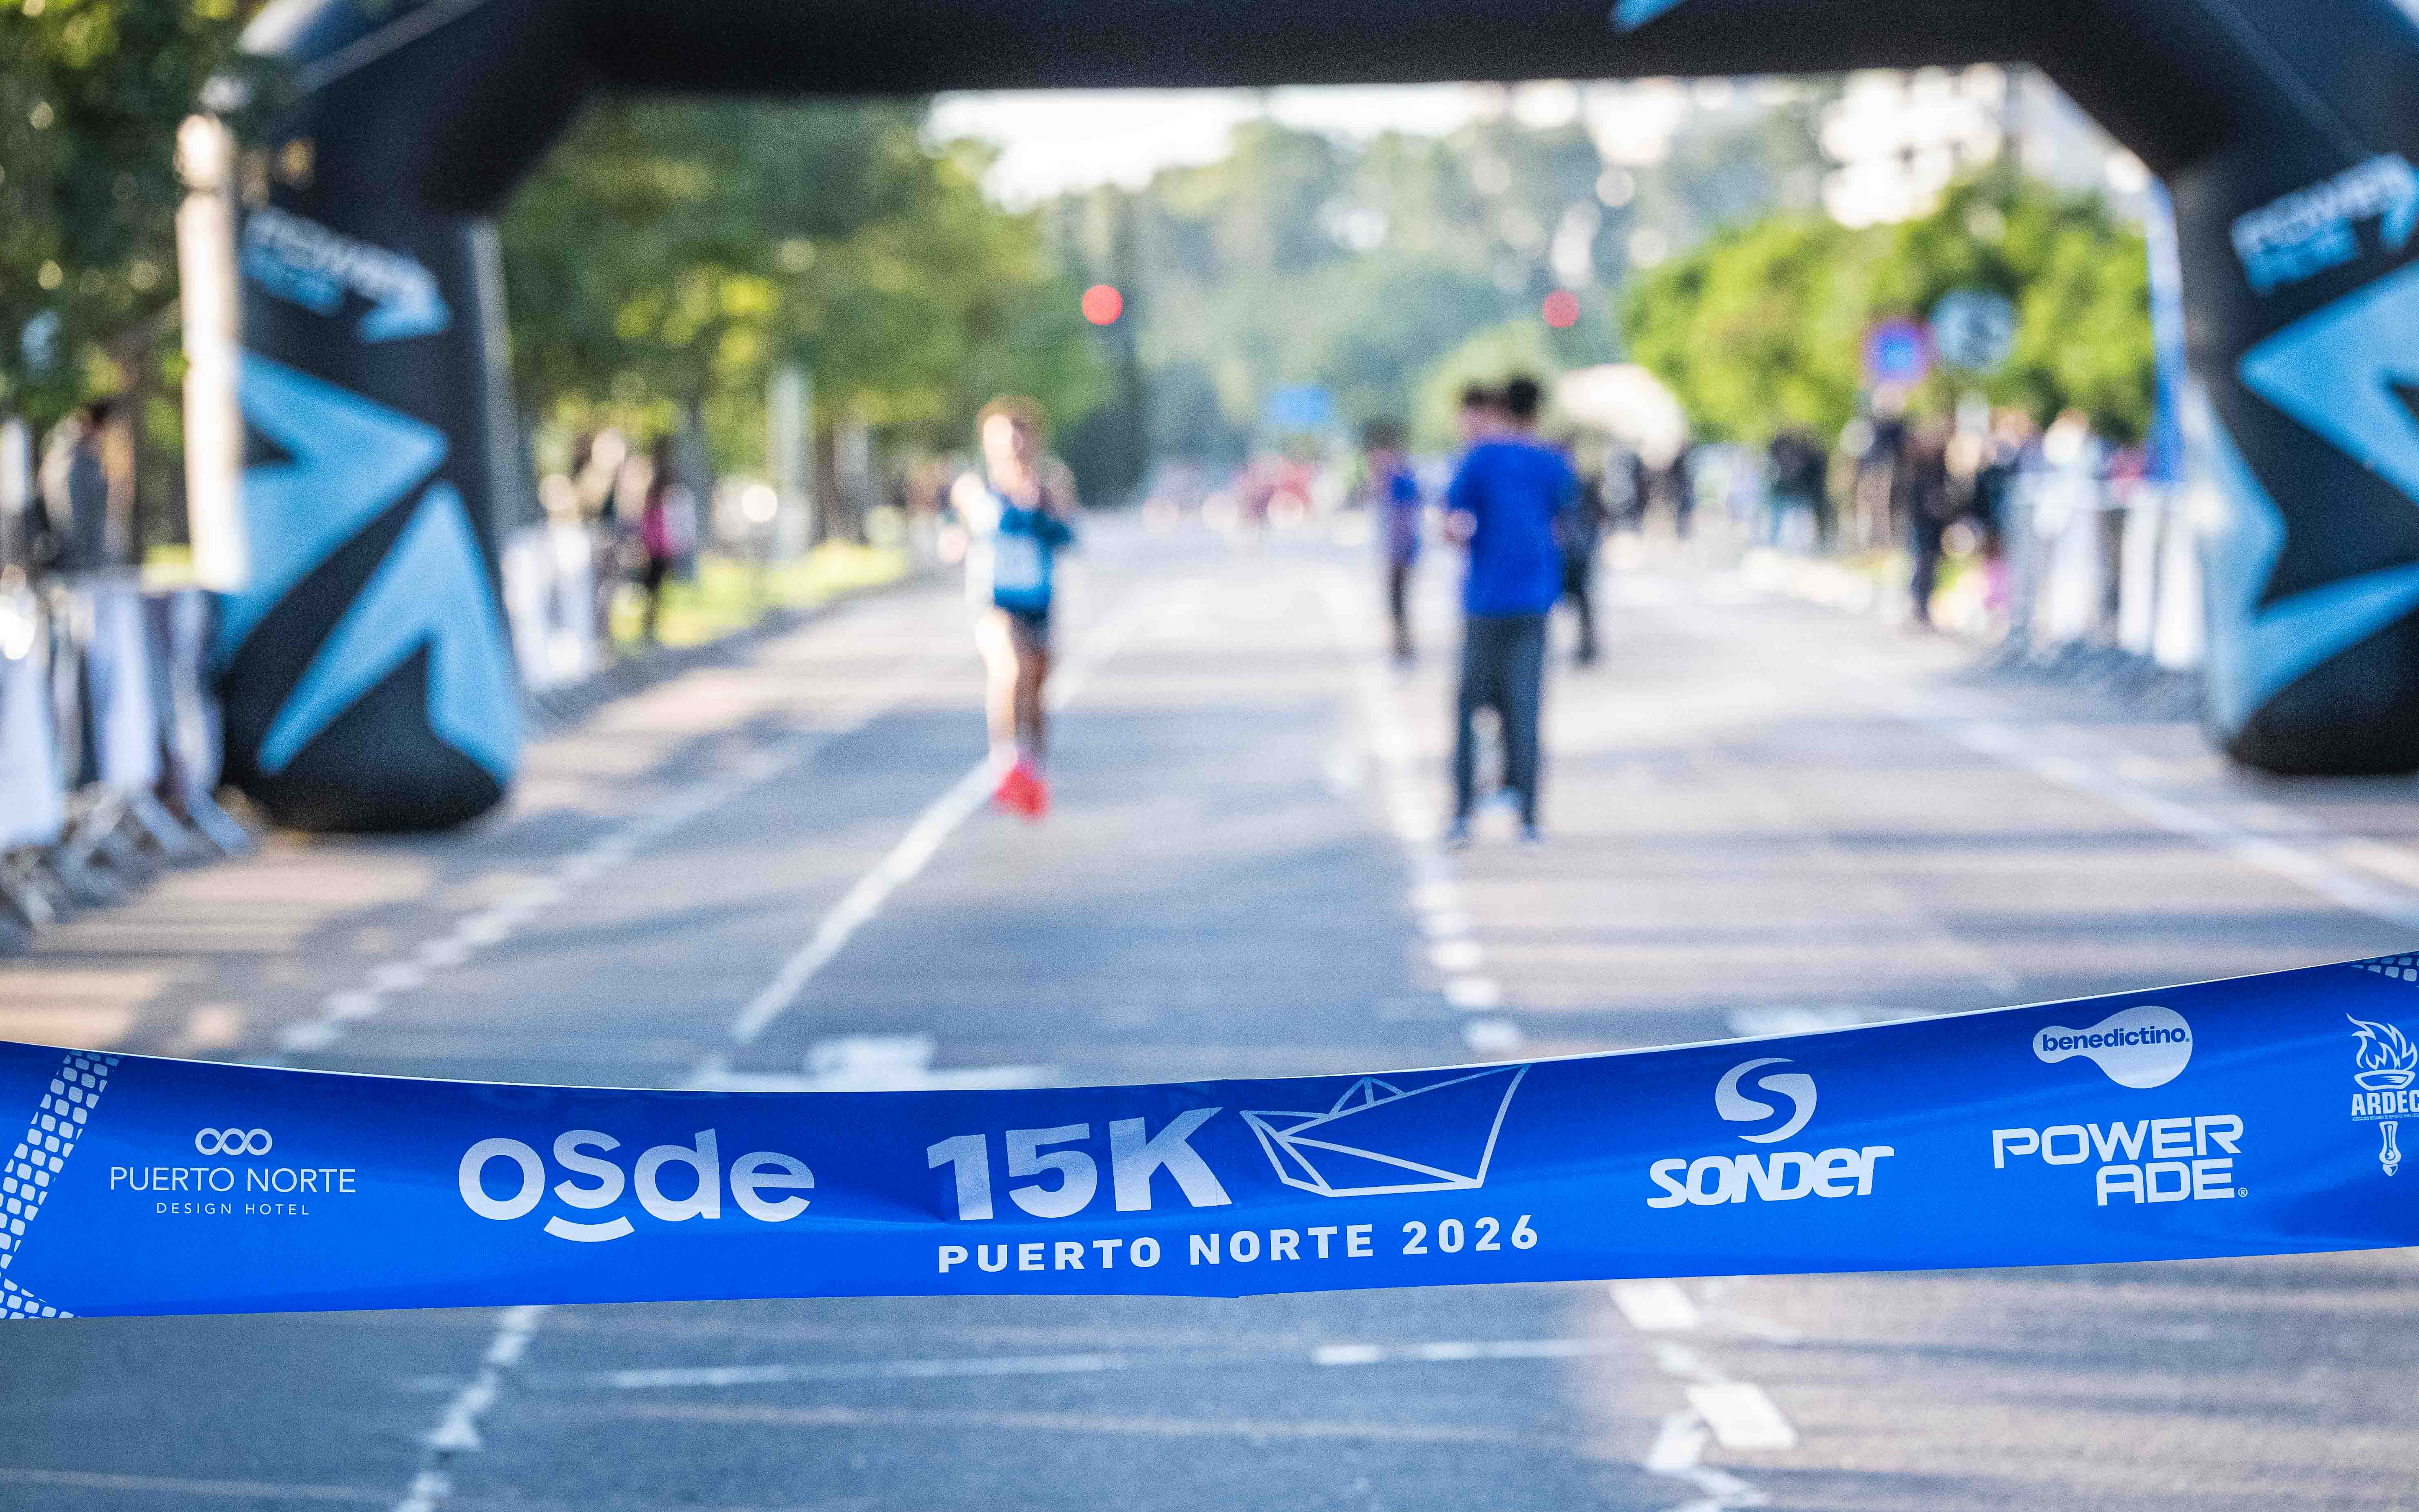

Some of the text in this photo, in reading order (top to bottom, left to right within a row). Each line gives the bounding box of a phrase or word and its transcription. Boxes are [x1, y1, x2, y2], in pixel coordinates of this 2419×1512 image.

[2351, 1090, 2419, 1116] ARDEC
[927, 1106, 1233, 1221] 15K
[1992, 1114, 2244, 1169] POWER
[111, 1166, 356, 1193] PUERTO NORTE
[458, 1128, 815, 1223] osde
[156, 1202, 309, 1215] DESIGN HOTEL
[938, 1214, 1538, 1273] PUERTO NORTE 2026
